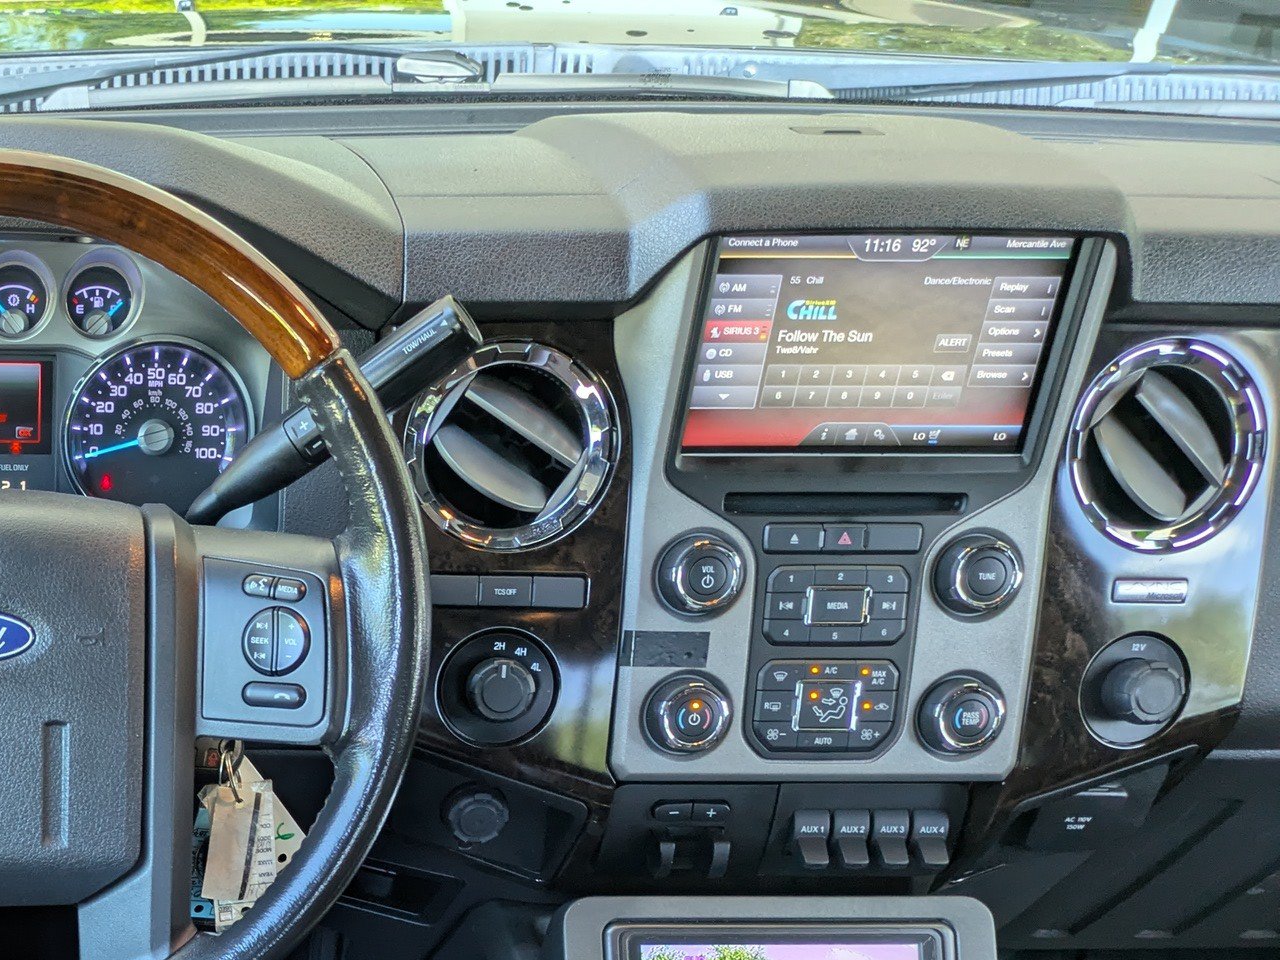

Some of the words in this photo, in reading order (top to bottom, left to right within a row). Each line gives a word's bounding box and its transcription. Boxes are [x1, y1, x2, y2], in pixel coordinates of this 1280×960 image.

[728, 237, 764, 247] Connect
[772, 238, 799, 248] Phone
[864, 238, 902, 253] 11:16
[955, 238, 970, 248] NE
[1006, 239, 1049, 248] Mercantile
[1050, 239, 1067, 248] Ave
[789, 276, 801, 284] 55
[924, 276, 992, 286] Dance/Electronic
[731, 283, 747, 293] AM
[999, 282, 1029, 293] Replay
[26, 304, 35, 314] H
[75, 304, 84, 314] E
[727, 304, 743, 313] FM
[993, 305, 1016, 315] Scan
[723, 327, 753, 336] SIRIUS
[777, 329, 819, 343] Follow
[822, 329, 845, 343] The
[847, 330, 873, 343] Sun
[988, 326, 1020, 337] Options
[401, 327, 437, 355] TOW/HAUL
[938, 337, 968, 347] ALERT
[718, 348, 733, 357] CD
[981, 349, 1013, 358] Presets
[124, 373, 143, 385] 40
[147, 368, 165, 380] 50
[714, 370, 734, 379] USB
[780, 369, 786, 379] 1
[812, 369, 820, 379] 2
[845, 369, 853, 379] 3
[878, 369, 886, 379] 4
[911, 369, 919, 379] 5
[976, 370, 1009, 380] Browse
[148, 380, 164, 388] MPH
[168, 374, 186, 385] 60
[109, 386, 128, 397] 30
[185, 386, 202, 398] 70
[808, 391, 815, 400] 7
[874, 391, 881, 400] 9
[906, 391, 914, 400] 0
[95, 401, 114, 413] 20
[165, 398, 178, 409] 100
[195, 402, 214, 414] 80
[121, 409, 131, 420] 40
[177, 408, 189, 421] 120
[89, 424, 104, 435] 10
[115, 424, 123, 436] 20
[185, 422, 194, 437] 140
[201, 425, 220, 437] 90
[912, 432, 926, 441] LO
[993, 432, 1007, 441] LO
[194, 448, 217, 459] 100
[13, 464, 29, 472] ONLY
[701, 565, 715, 574] VOL
[788, 574, 794, 583] 1
[837, 572, 844, 581] 2
[886, 574, 894, 583] 3
[978, 572, 996, 580] TUNE
[277, 584, 298, 594] MEDIA
[494, 588, 506, 596] TCS
[506, 588, 517, 596] OFF
[826, 601, 849, 610] MEDIA
[782, 628, 790, 637] 4
[831, 631, 839, 640] 5
[880, 628, 888, 637] 6
[250, 636, 269, 645] SEEK
[284, 638, 297, 646] VOL
[493, 642, 506, 651] 2H
[1131, 643, 1147, 652] 12V
[514, 647, 528, 657] 4H
[530, 662, 542, 672] 4L
[824, 666, 838, 675] A/C
[871, 670, 887, 678] MAX
[871, 678, 885, 686] A/C
[962, 718, 980, 726] TEMP
[813, 737, 833, 745] AUTO
